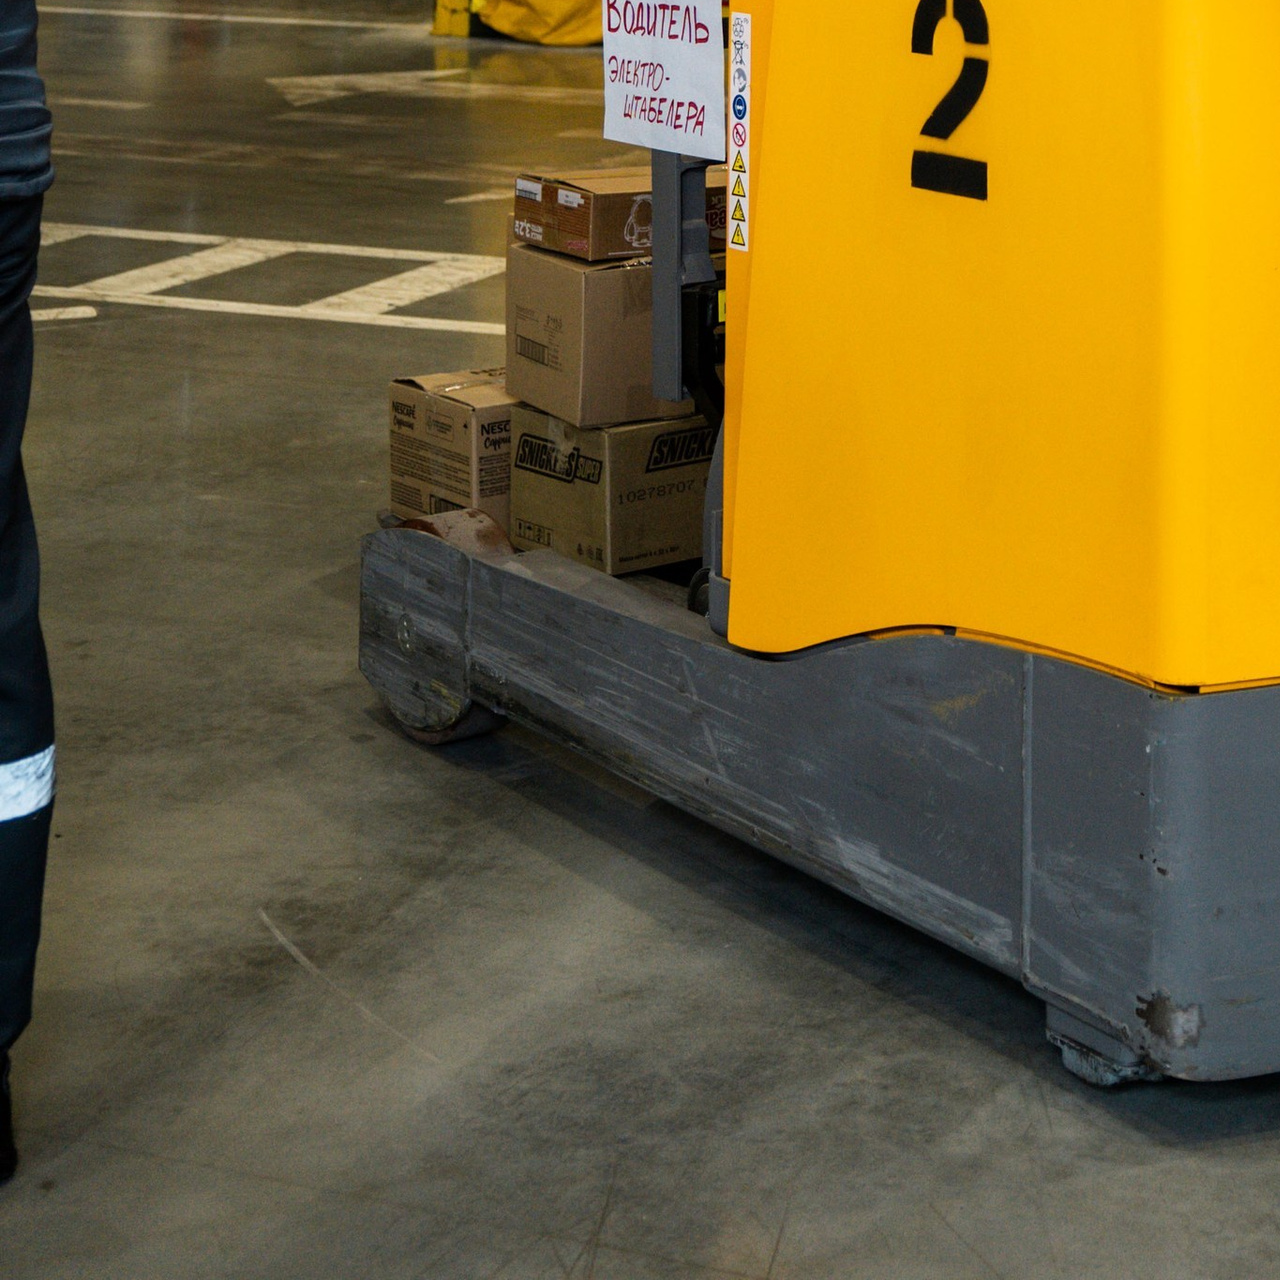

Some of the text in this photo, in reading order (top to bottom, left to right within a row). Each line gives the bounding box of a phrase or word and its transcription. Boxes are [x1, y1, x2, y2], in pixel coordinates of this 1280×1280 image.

[608, 55, 671, 91] ЭЛЕКТРО-
[623, 94, 706, 137] ШТАБЕЛЕРА
[480, 420, 511, 437] NESC
[651, 428, 716, 467] SNICK
[618, 479, 695, 505] 10278707
